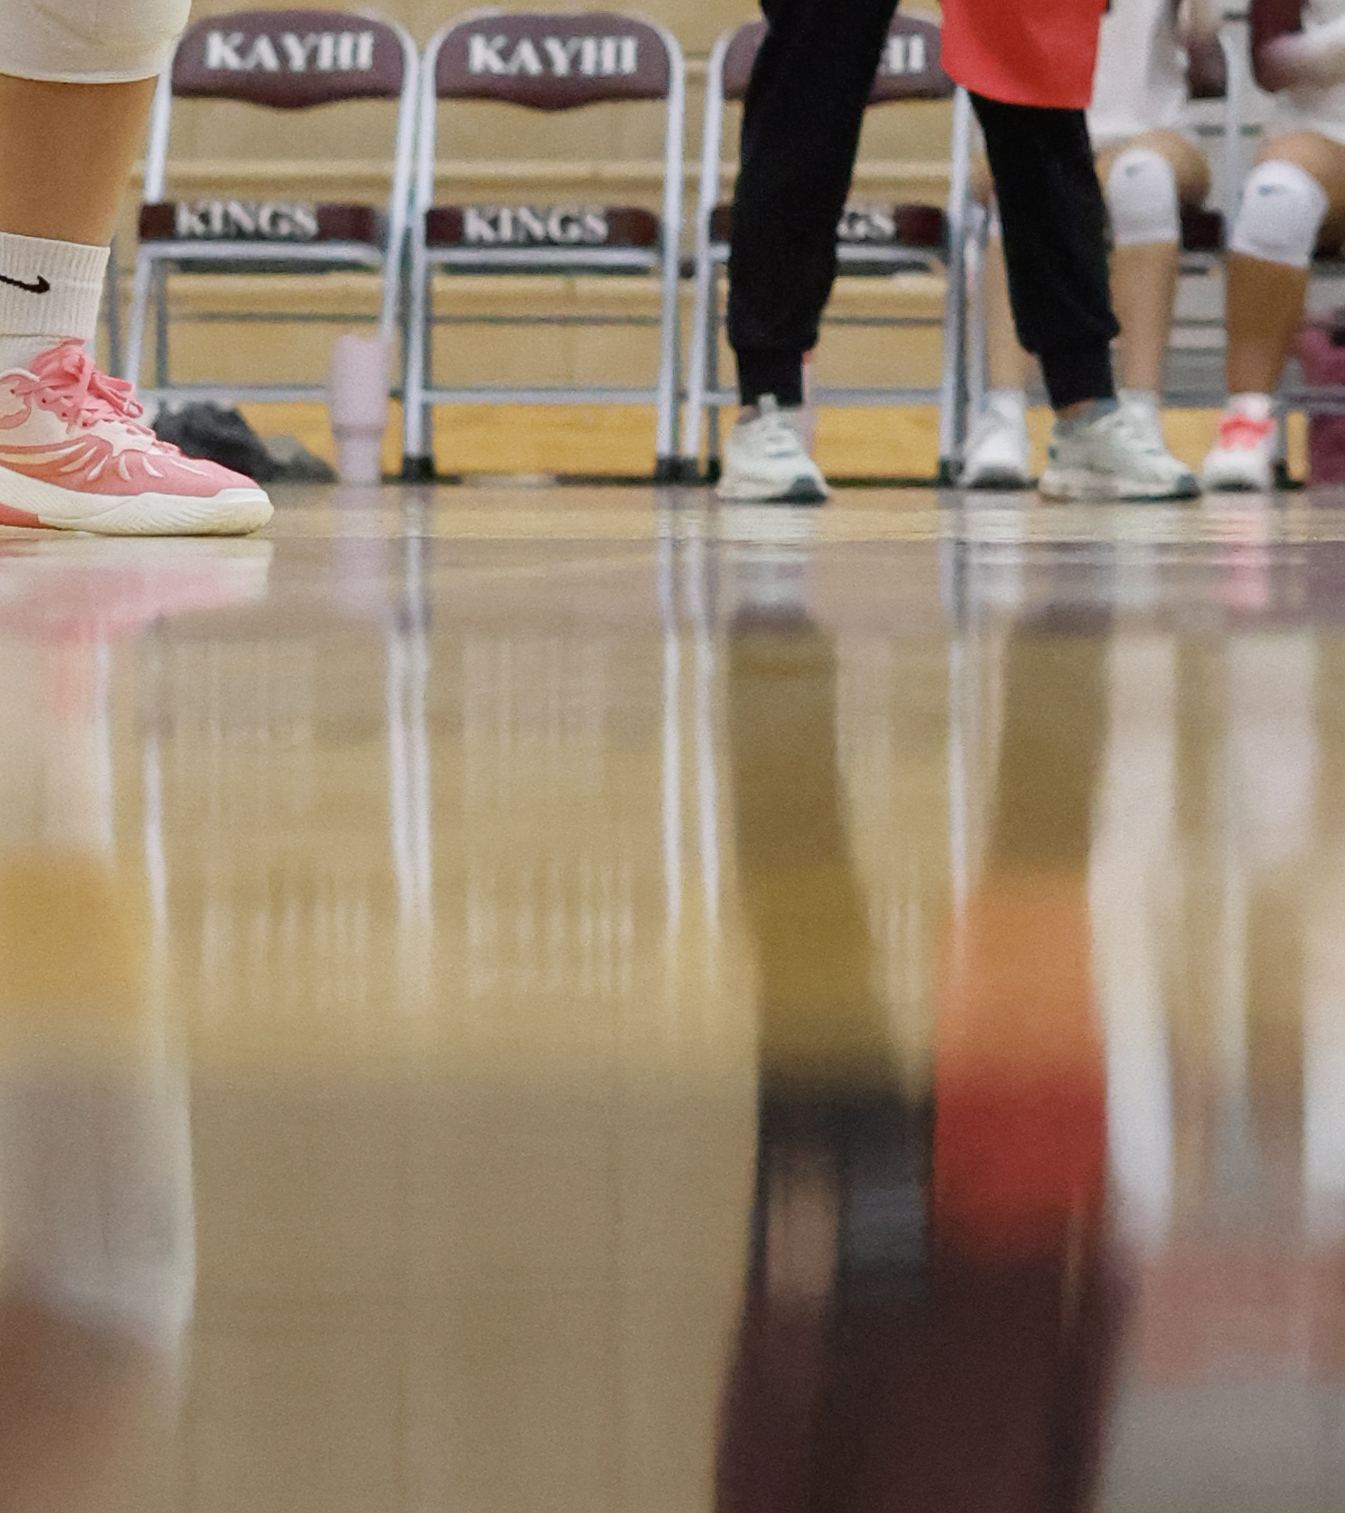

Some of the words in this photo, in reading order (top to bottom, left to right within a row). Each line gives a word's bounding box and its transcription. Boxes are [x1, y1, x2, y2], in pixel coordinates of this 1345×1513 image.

[207, 31, 374, 72] KAYHI
[468, 33, 636, 76] KAYHI
[173, 200, 320, 238] KINGS
[463, 204, 609, 243] KINGS
